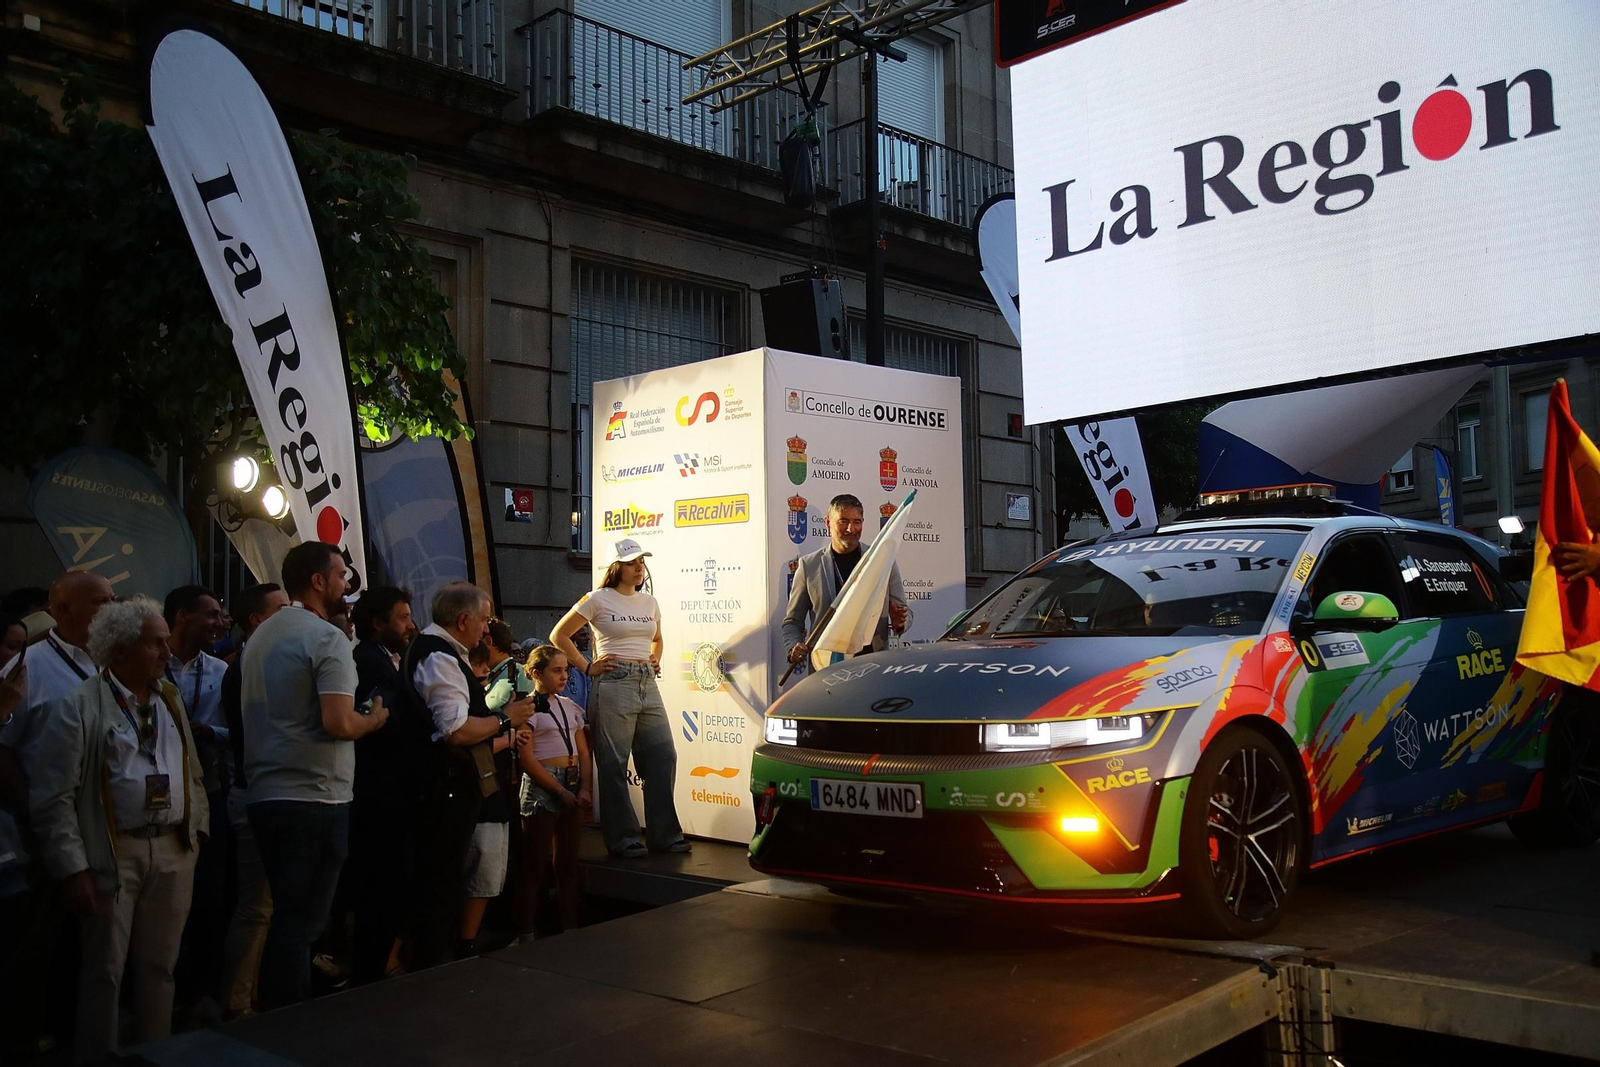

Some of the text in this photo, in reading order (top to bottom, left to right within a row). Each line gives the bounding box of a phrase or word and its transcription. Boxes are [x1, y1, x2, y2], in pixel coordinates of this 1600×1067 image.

[1042, 68, 1561, 263] La Región
[191, 162, 264, 299] La
[630, 406, 666, 419] Real Federación
[731, 412, 752, 420] Deportes
[805, 397, 945, 428] Concello de OURENSE
[633, 417, 654, 428] Española
[811, 457, 844, 467] Concello de
[617, 463, 665, 478] MICHELIN
[812, 470, 850, 481] AMOEIRO
[902, 465, 932, 475] Concello de
[1078, 421, 1141, 530] egió
[902, 478, 939, 488] A ARNOIA
[604, 508, 664, 528] Rallycar
[689, 501, 734, 521] Recalvi
[926, 522, 933, 530] de
[902, 532, 940, 543] CARTELLE
[1097, 540, 1265, 557] HYUNDAI
[1295, 554, 1315, 582] MEYCOM
[903, 579, 926, 587] Concello
[681, 597, 742, 610] DEPUTACIÓN
[1280, 589, 1298, 620] VIMESA
[611, 614, 627, 622] La
[689, 613, 733, 624] OURENSE
[882, 663, 1071, 677] WATTSON
[1456, 648, 1505, 680] RACE
[1157, 665, 1213, 692] sparco
[705, 715, 746, 728] DEPORTE
[1424, 702, 1510, 743] WATTSON
[706, 731, 743, 744] GALEGO
[1086, 766, 1152, 793] RACE
[691, 789, 741, 808] telemiño
[822, 780, 918, 815] 6484 MND
[1359, 813, 1394, 828] MICHELIN
